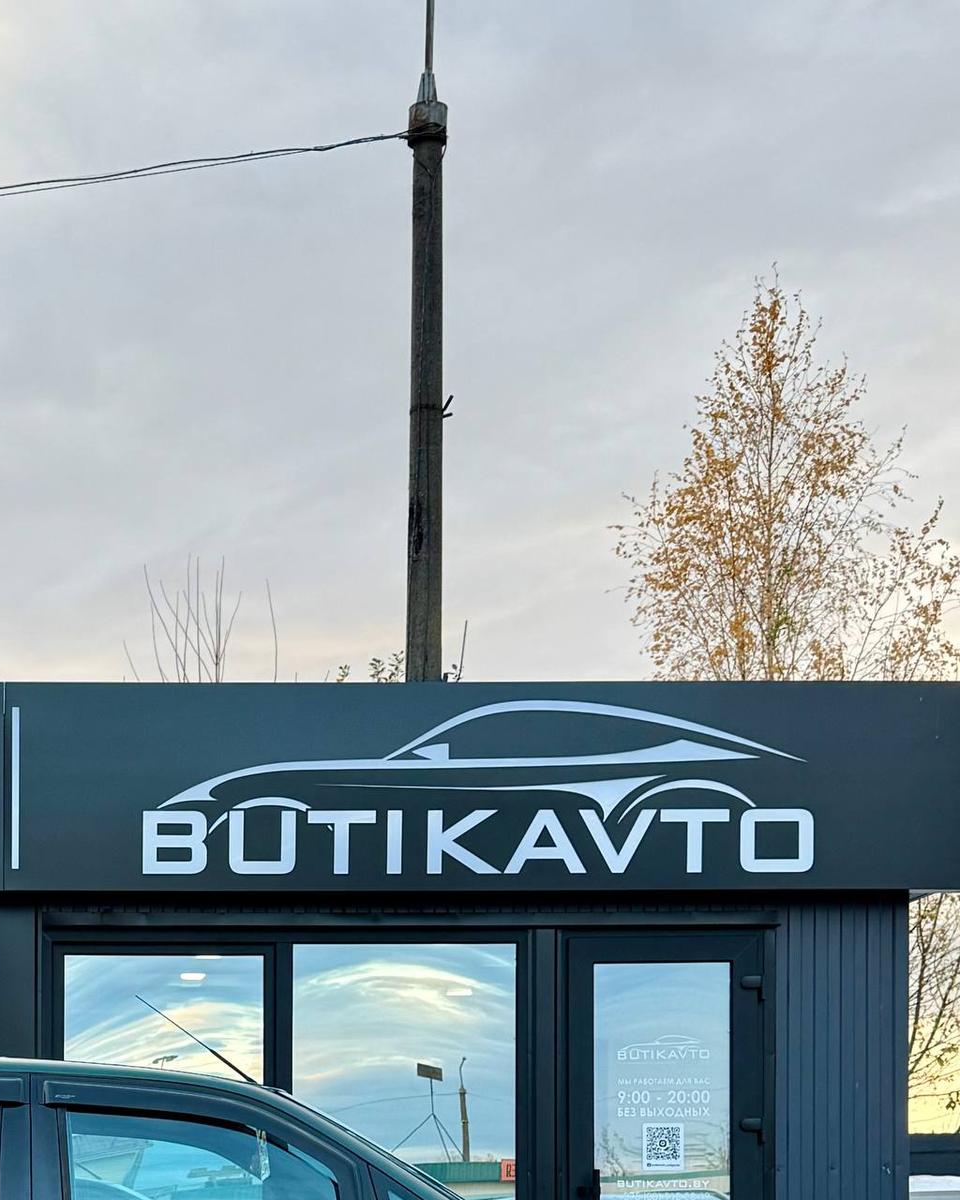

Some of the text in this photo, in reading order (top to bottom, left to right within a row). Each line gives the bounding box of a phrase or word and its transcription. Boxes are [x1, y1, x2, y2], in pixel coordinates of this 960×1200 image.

[142, 808, 814, 875] BUTIKAVTO
[617, 1049, 710, 1060] BUTIKAVTO
[633, 1078, 674, 1086] РАБОТАЕМ
[617, 1090, 650, 1104] 9:00
[667, 1090, 710, 1104] 20:00
[617, 1107, 710, 1118] БЕЗ ВЫХОДНЫХ
[617, 1179, 710, 1188] BUTIKAVTO.BY
